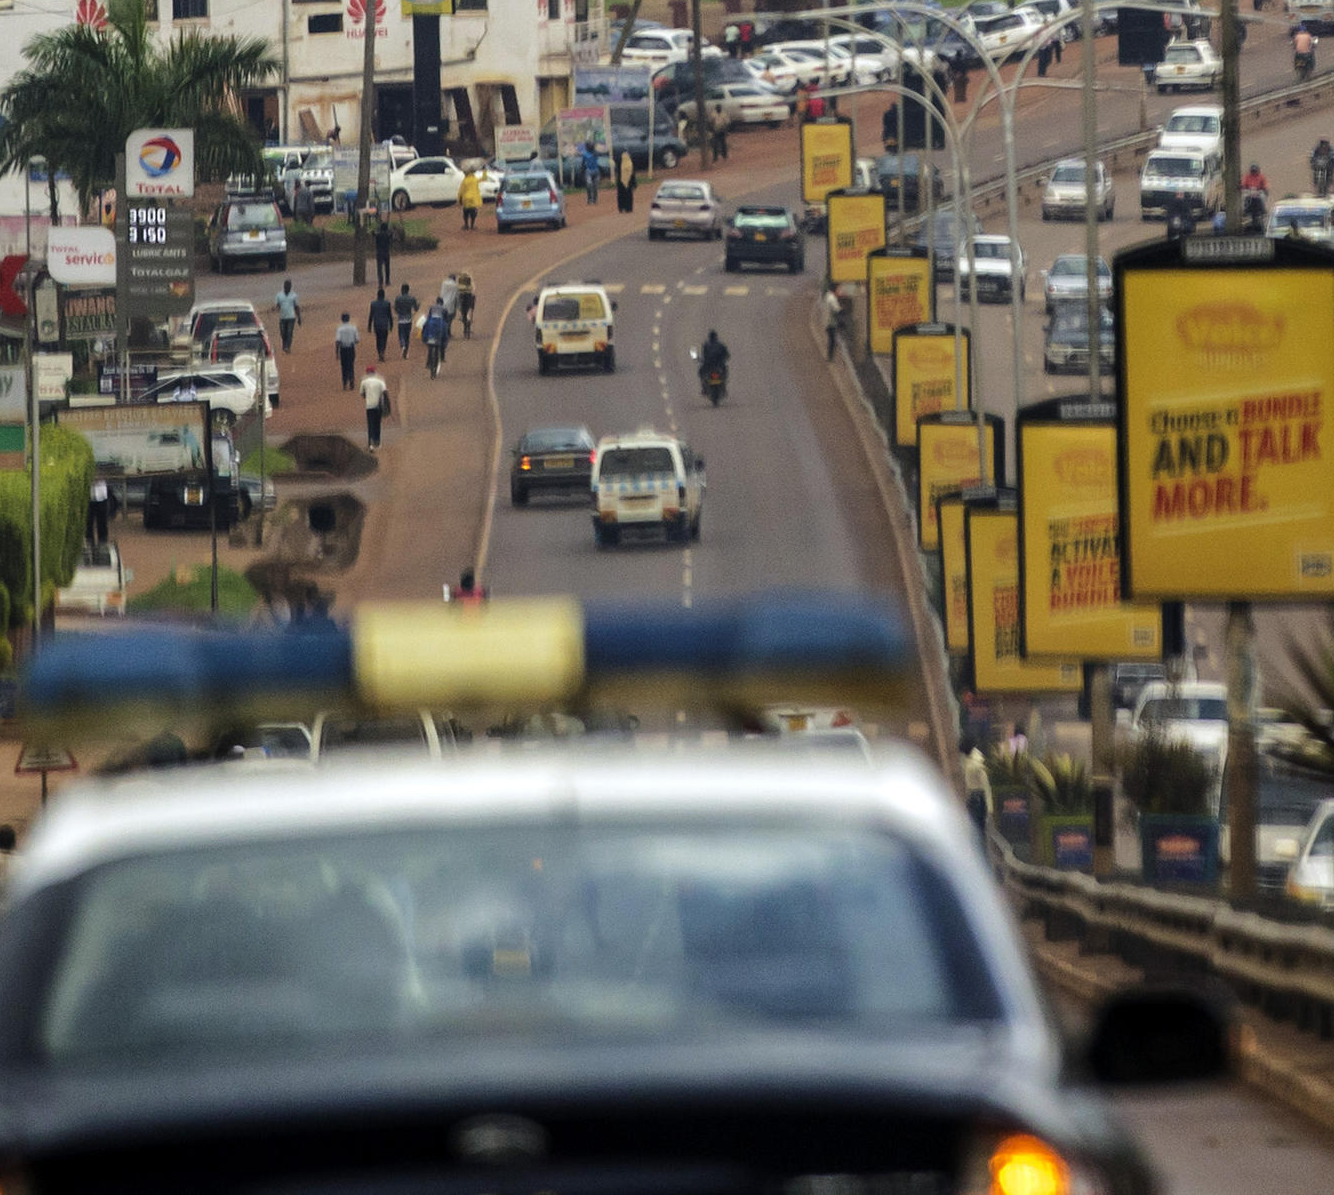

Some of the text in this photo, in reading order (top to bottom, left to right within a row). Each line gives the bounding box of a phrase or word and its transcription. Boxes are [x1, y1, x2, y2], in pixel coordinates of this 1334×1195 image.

[136, 182, 185, 195] TOTAL
[132, 247, 187, 259] LUBRICANTS
[1151, 421, 1323, 481] AND TALK
[1152, 475, 1269, 525] MORE.
